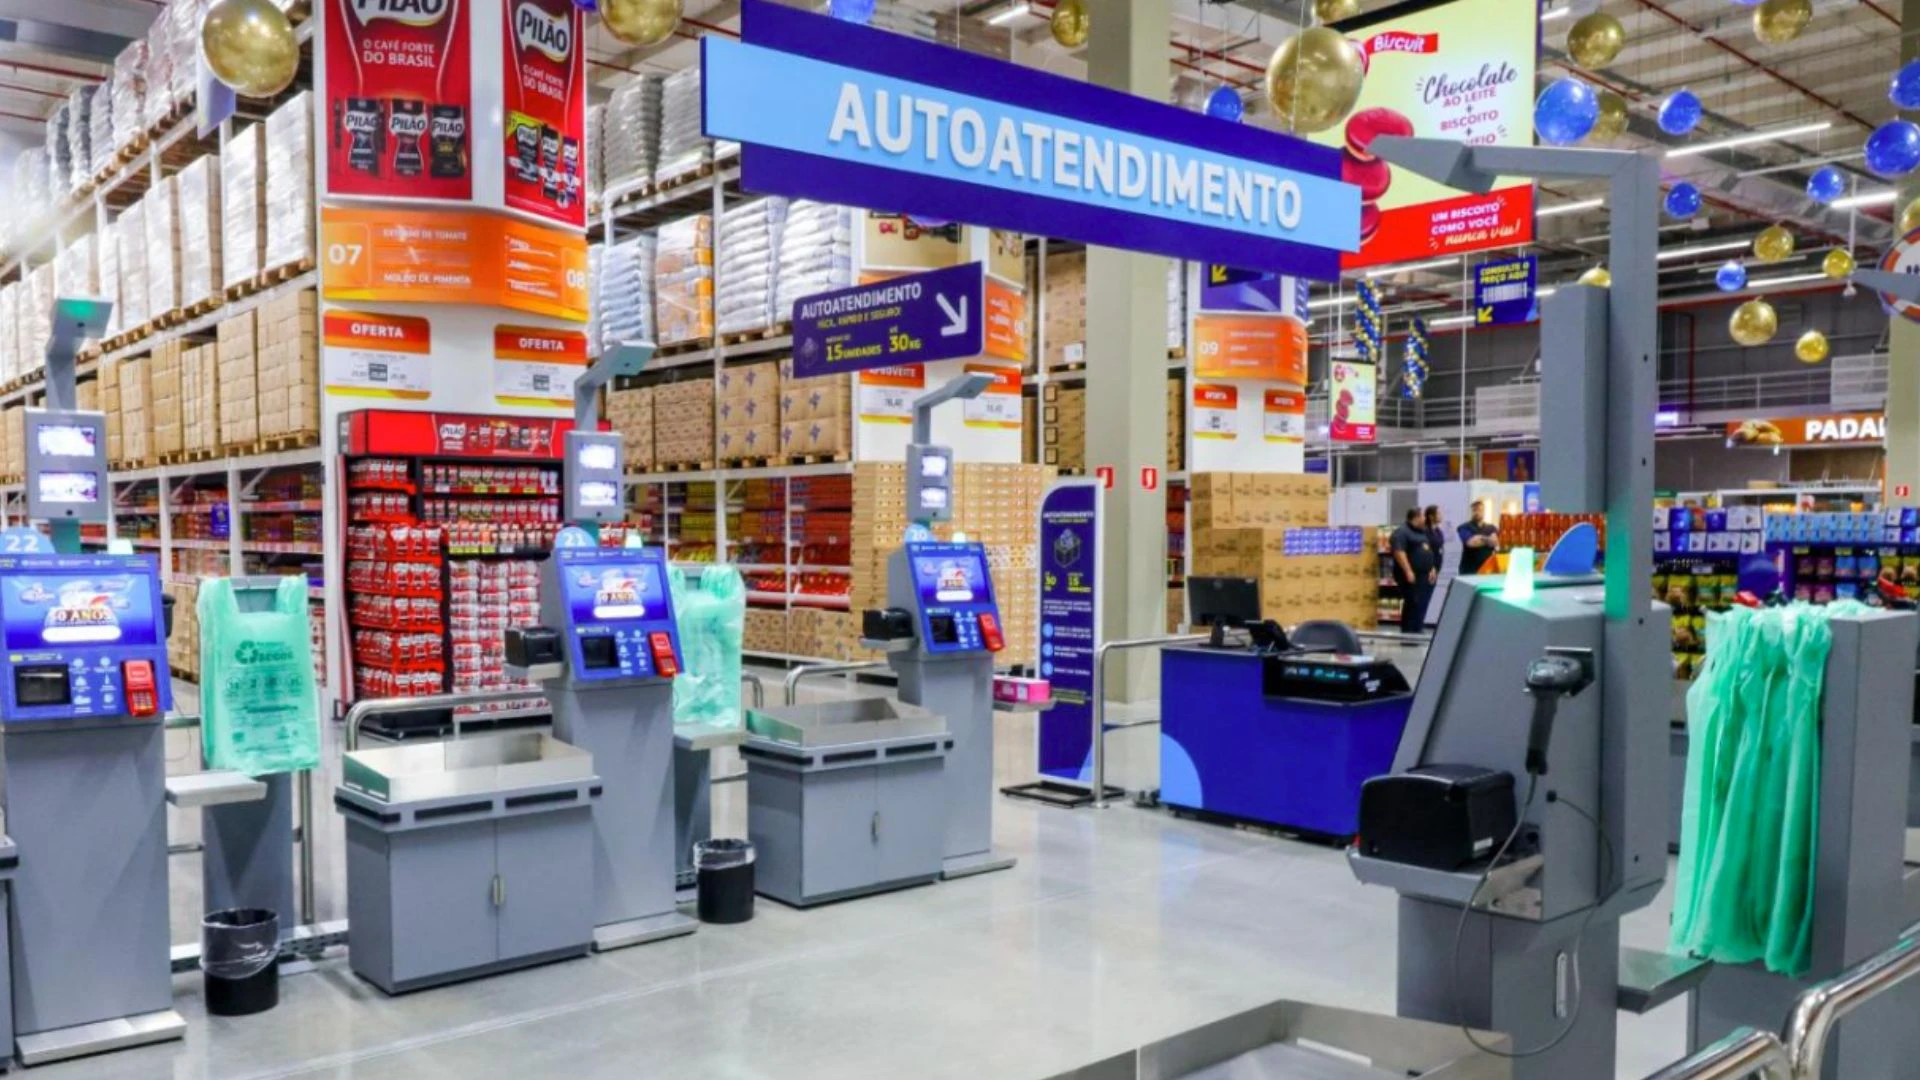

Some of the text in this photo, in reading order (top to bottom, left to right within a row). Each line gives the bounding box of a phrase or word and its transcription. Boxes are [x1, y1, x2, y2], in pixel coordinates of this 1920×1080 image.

[520, 8, 567, 52] PILÃO
[363, 39, 434, 54] O CAFÉ FORTE
[1374, 35, 1426, 52] Biscuit
[363, 51, 435, 68] DO BRASIL
[1423, 61, 1518, 105] Chocolate
[1443, 86, 1496, 107] AO LEITE
[1440, 110, 1499, 131] BISCOITO
[828, 82, 1303, 230] AUTOATENDIMENTO
[1431, 202, 1500, 222] UM BISCOITO
[1431, 213, 1498, 235] COMO VOCÊ
[328, 243, 363, 266] 07
[566, 269, 586, 290] 08
[801, 283, 921, 319] AUTOATENDIMENTO
[350, 322, 405, 338] OFERTA
[518, 337, 565, 352] OFERTA
[827, 342, 843, 362] 15
[889, 333, 910, 353] 30
[5, 534, 39, 552] 22
[564, 532, 587, 547] 21
